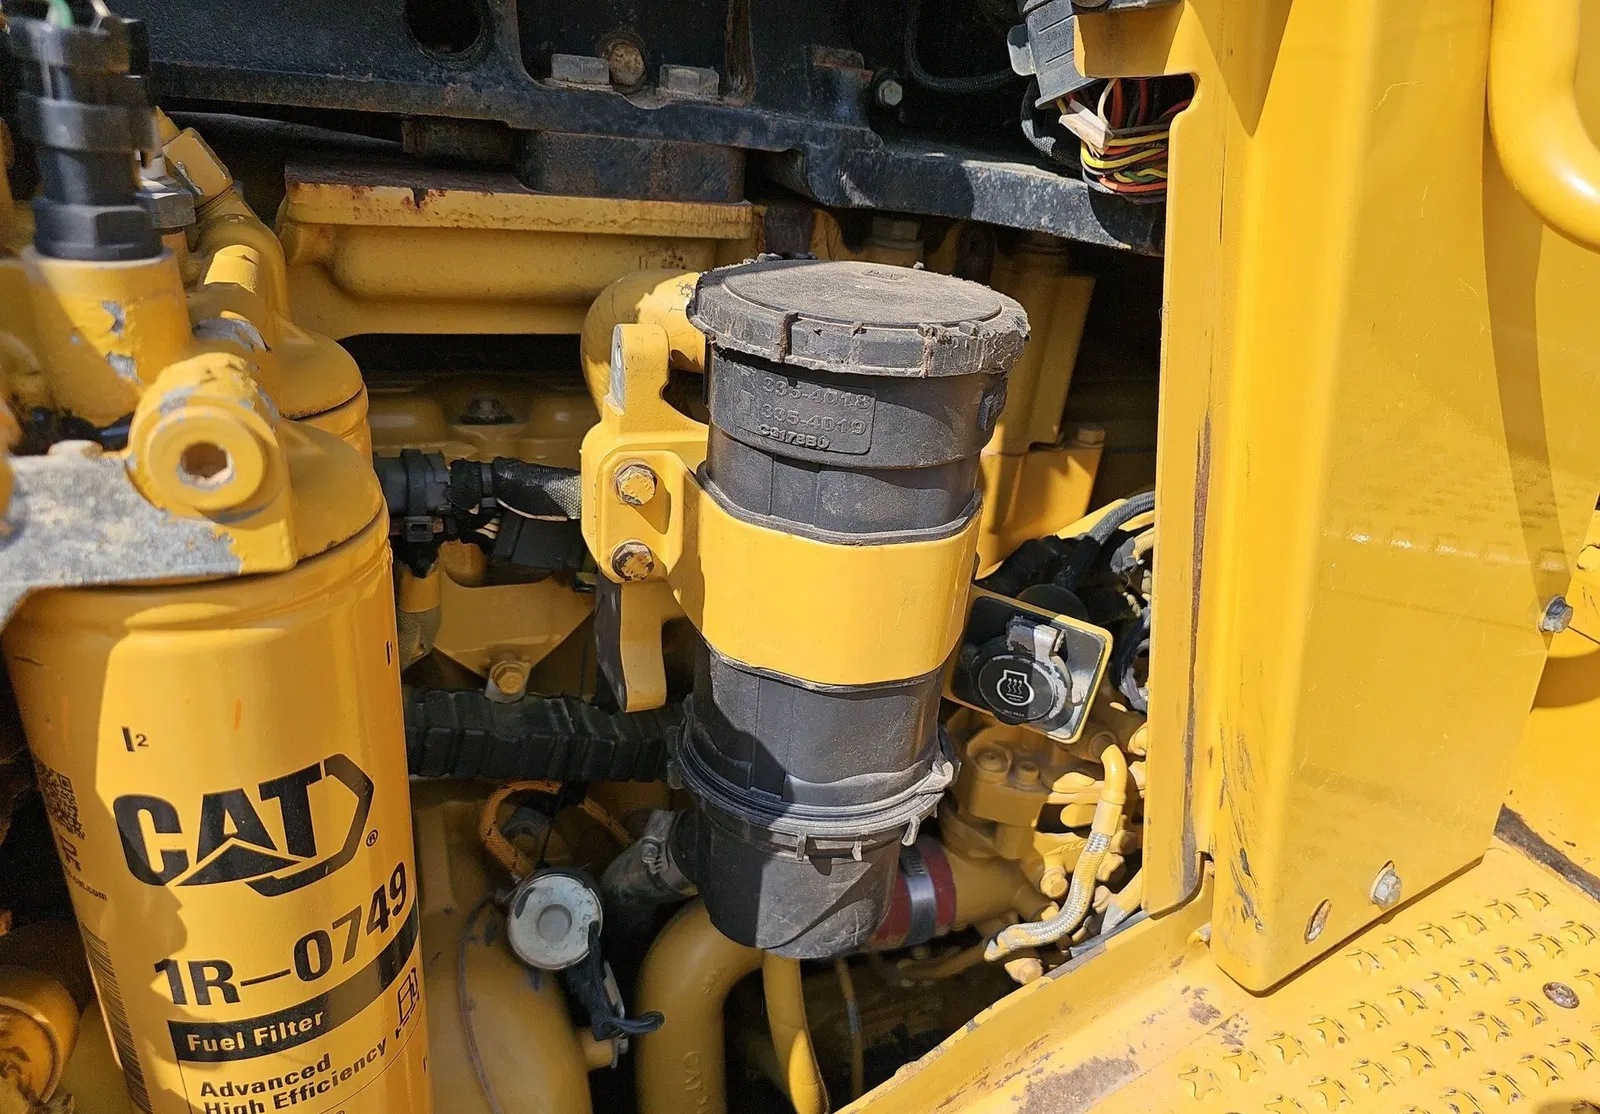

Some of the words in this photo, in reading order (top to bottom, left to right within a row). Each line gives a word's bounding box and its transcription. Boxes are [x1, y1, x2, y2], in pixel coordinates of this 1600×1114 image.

[762, 377, 872, 409] 335-4018
[761, 403, 867, 436] 335-4019
[113, 761, 323, 888] CAT
[186, 1031, 245, 1052] Fuel
[253, 1010, 325, 1047] Filter
[200, 1052, 331, 1098] Advanced
[204, 1098, 265, 1114] High
[273, 1036, 387, 1111] Efficiency
